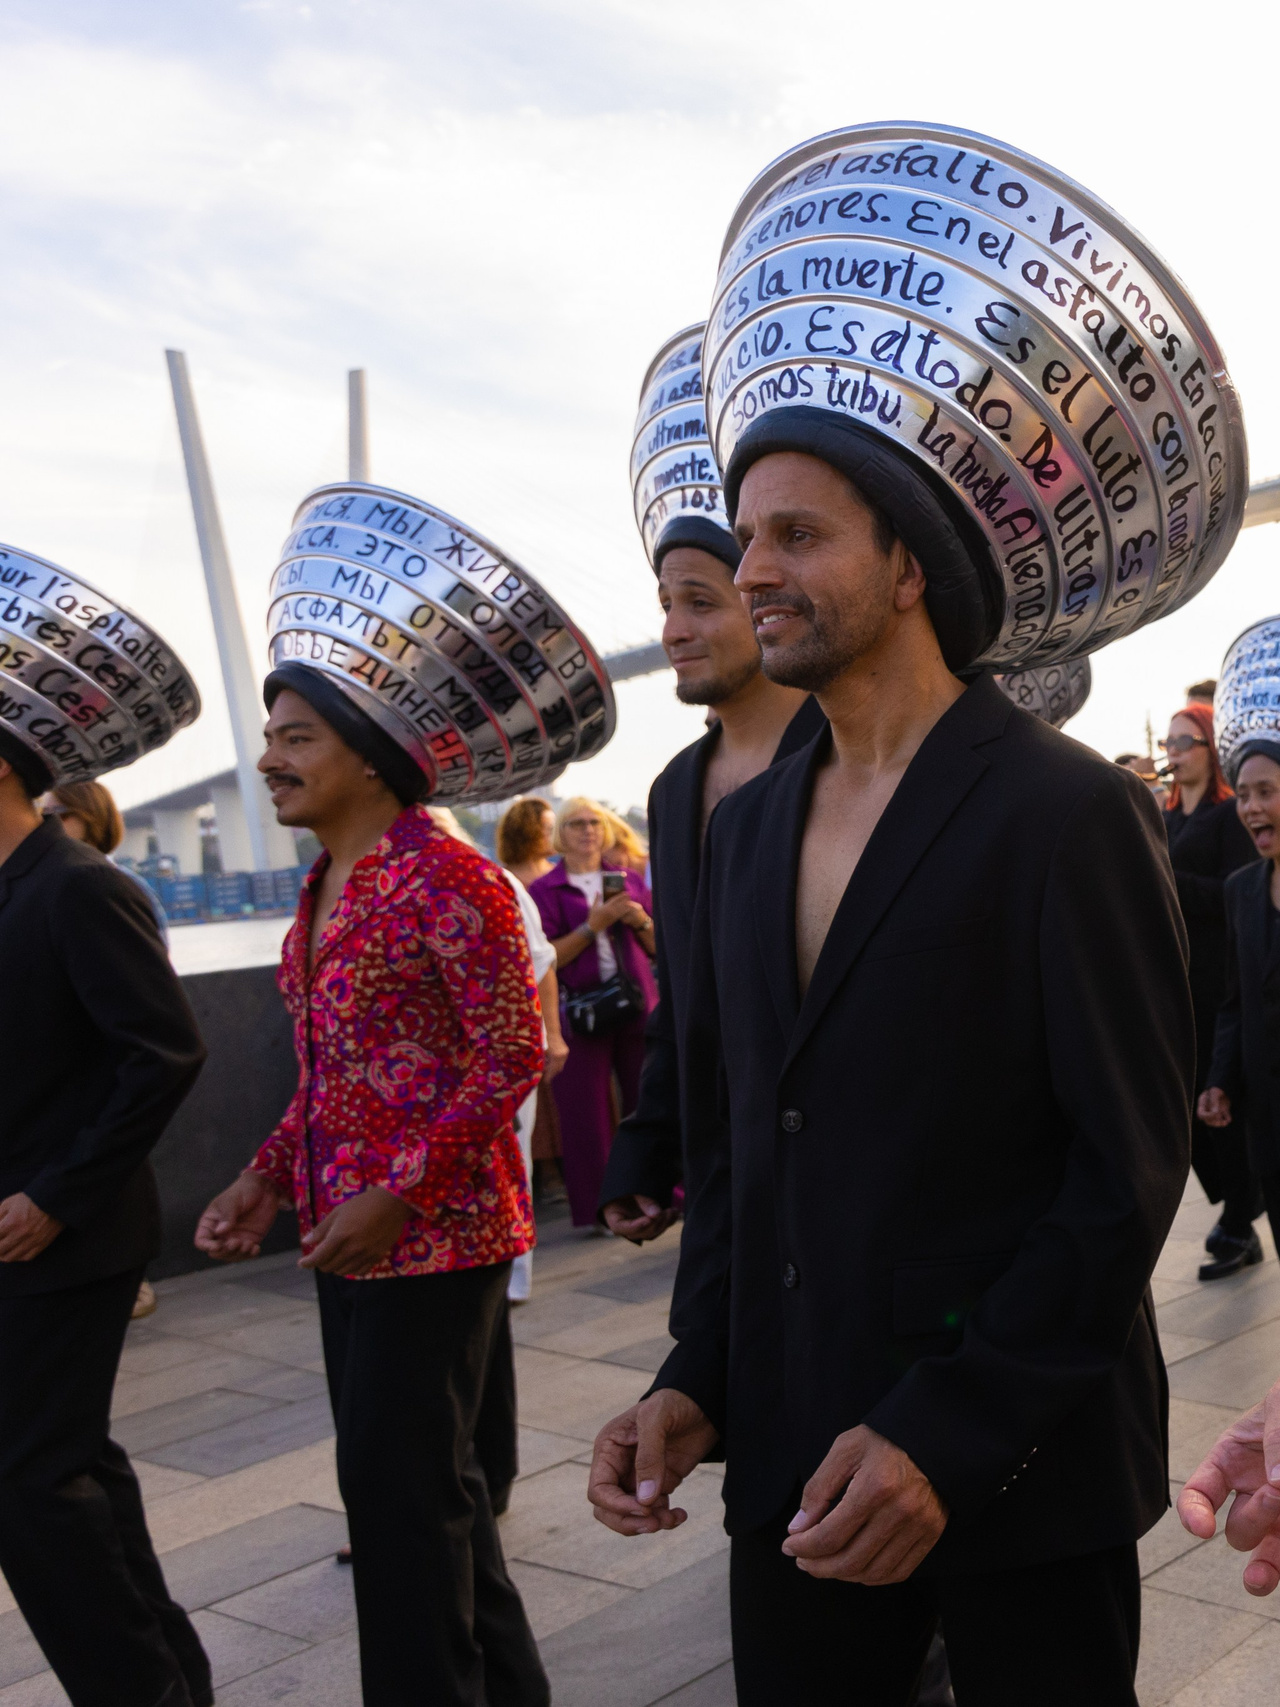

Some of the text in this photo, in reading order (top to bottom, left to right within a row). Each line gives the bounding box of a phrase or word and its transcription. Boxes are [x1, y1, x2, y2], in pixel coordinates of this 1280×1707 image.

[842, 145, 1036, 223] asfalto.
[1050, 206, 1182, 373] Vivimos.
[757, 259, 792, 301] la
[802, 251, 953, 313] muerte.
[975, 301, 1037, 364] Es
[1042, 360, 1093, 423] el
[1082, 404, 1142, 524] luto.
[1117, 529, 1158, 583] Es
[805, 306, 865, 356] Es
[1016, 422, 1063, 488] De
[1021, 260, 1156, 402] asfalto
[1153, 411, 1189, 485] con
[331, 565, 390, 605] МЫ
[733, 364, 814, 432] Somos
[825, 362, 902, 428] tribu.
[991, 507, 1048, 659] Alienados
[0, 596, 78, 656] bres.
[279, 596, 423, 672] АСФАЛЬТ.
[356, 532, 428, 578] ЭТО
[444, 581, 549, 692] ГОЛОД.
[558, 649, 587, 679] В
[34, 667, 111, 732] C'est
